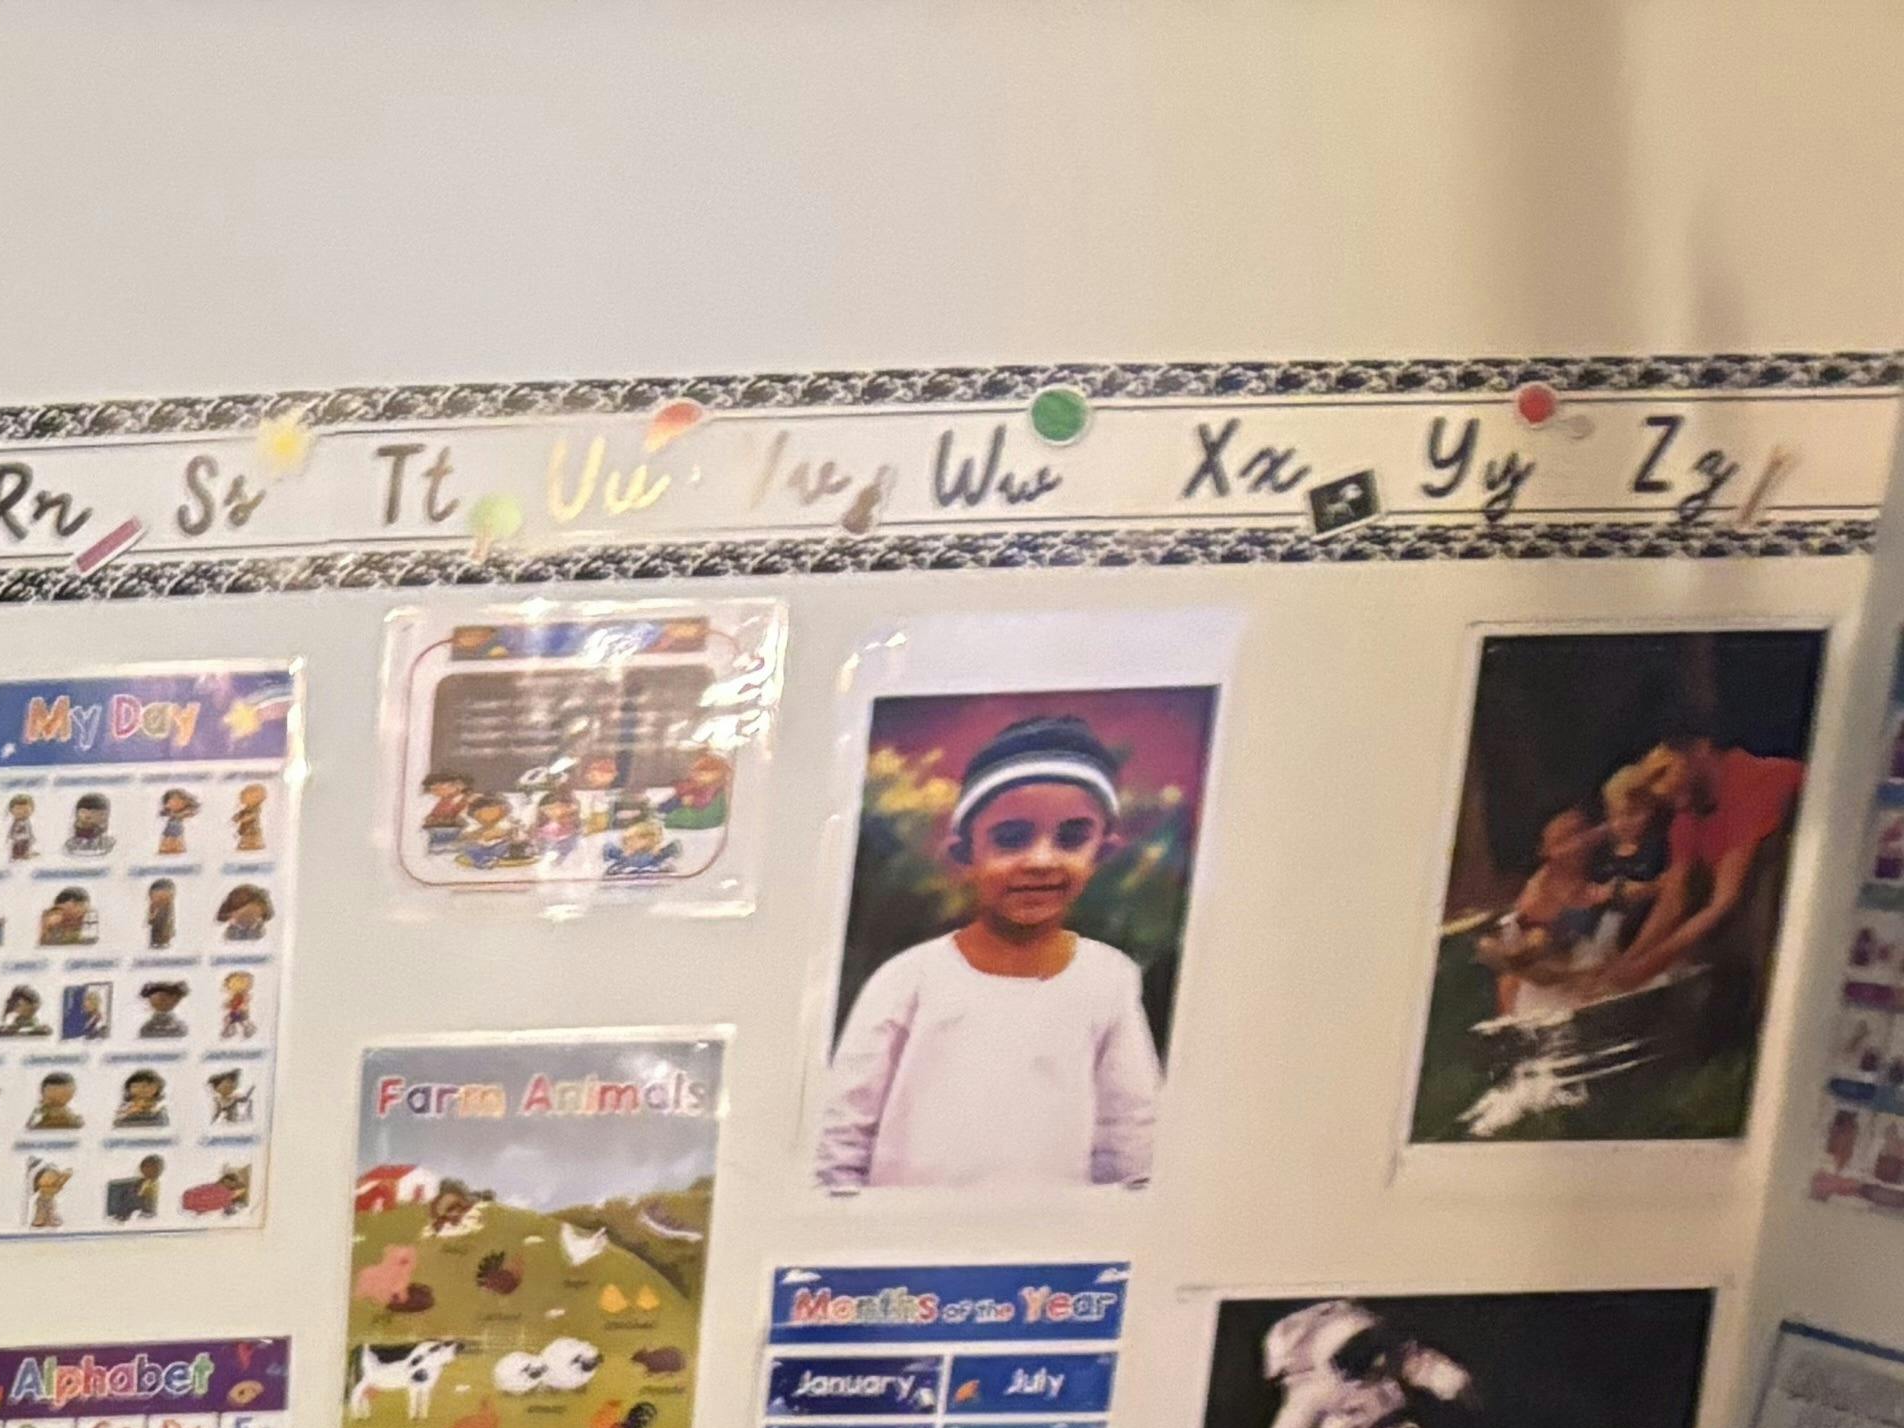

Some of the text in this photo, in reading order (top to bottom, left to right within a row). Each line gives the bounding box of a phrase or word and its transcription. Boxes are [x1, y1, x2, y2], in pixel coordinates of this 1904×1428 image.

[176, 455, 266, 535] Ss
[376, 444, 461, 526] Tt
[549, 439, 670, 521] Uu
[929, 426, 1062, 506] Ww
[1184, 419, 1311, 499] Xx
[1420, 416, 1536, 520] Yy
[1633, 416, 1739, 522] Zz
[26, 693, 201, 751] My Day
[377, 1070, 708, 1119] Farm Animals
[792, 1285, 1117, 1325] Months of the Year
[9, 1352, 216, 1412] Alphabet
[792, 1370, 916, 1400] January
[1003, 1368, 1064, 1399] July
